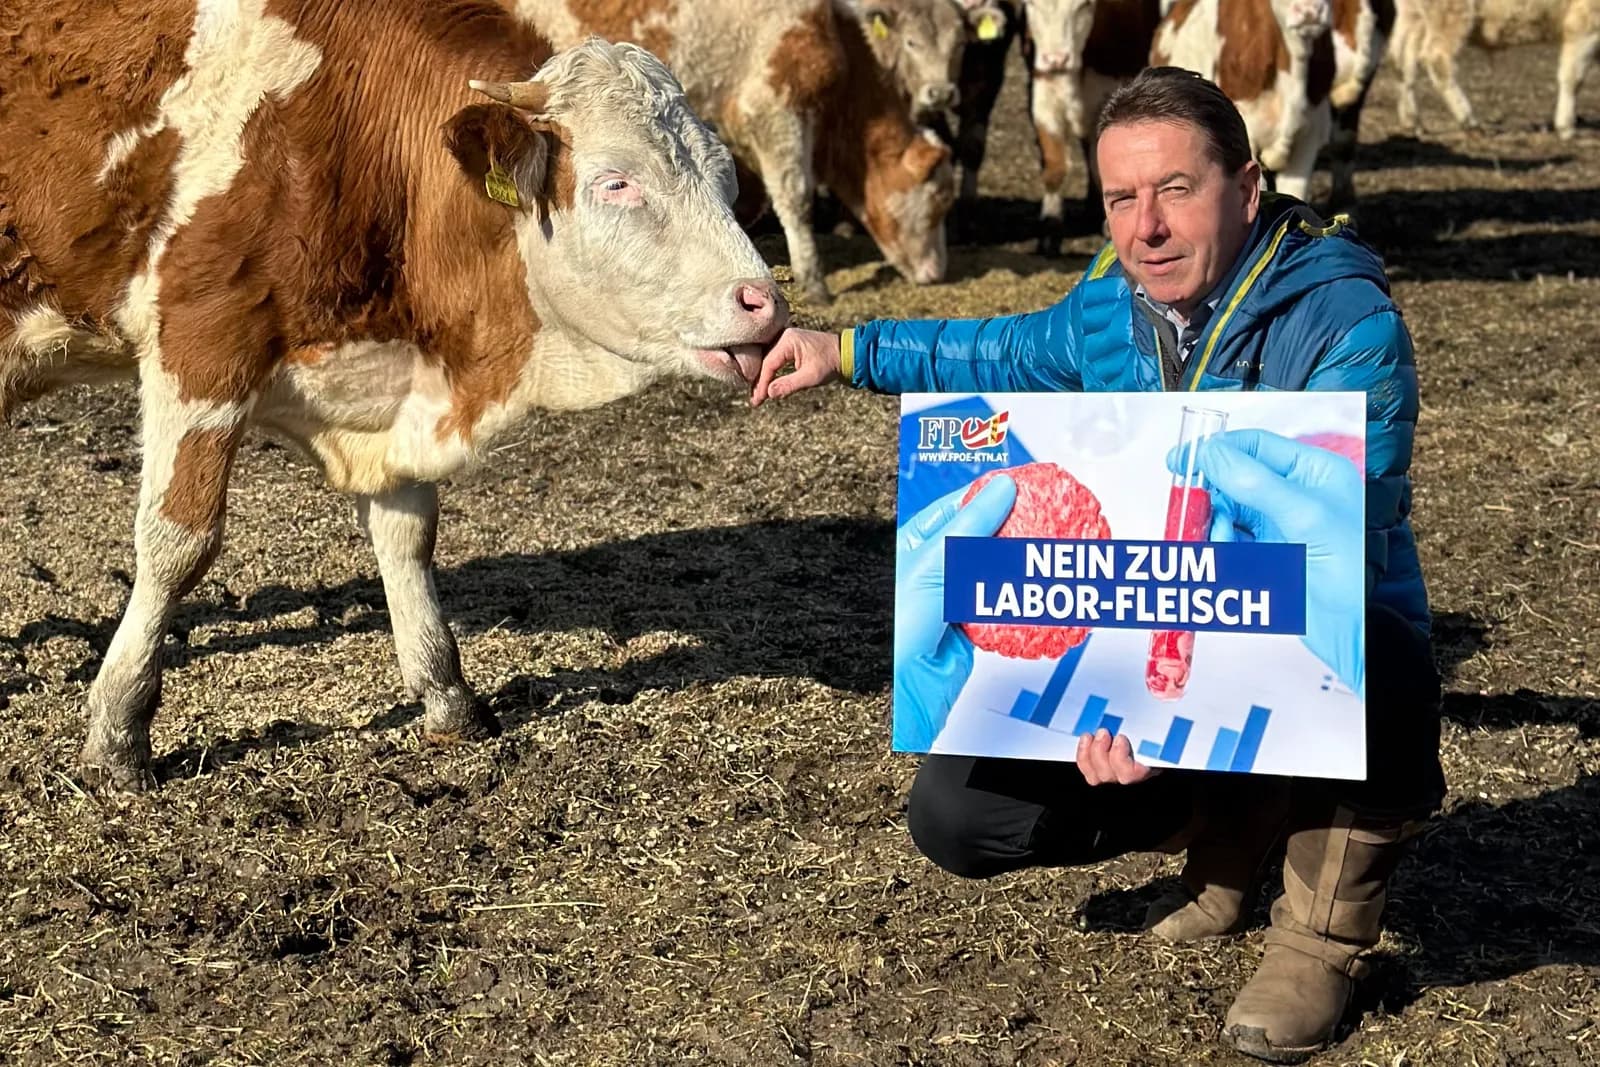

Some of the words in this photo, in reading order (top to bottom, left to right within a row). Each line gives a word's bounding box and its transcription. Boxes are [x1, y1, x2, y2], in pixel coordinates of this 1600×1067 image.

[918, 452, 1009, 463] WWW.FPOE-KTN.AT
[1025, 543, 1115, 580] NEIN
[1125, 546, 1217, 583] ZUM
[975, 582, 1270, 626] LABOR-FLEISCH
